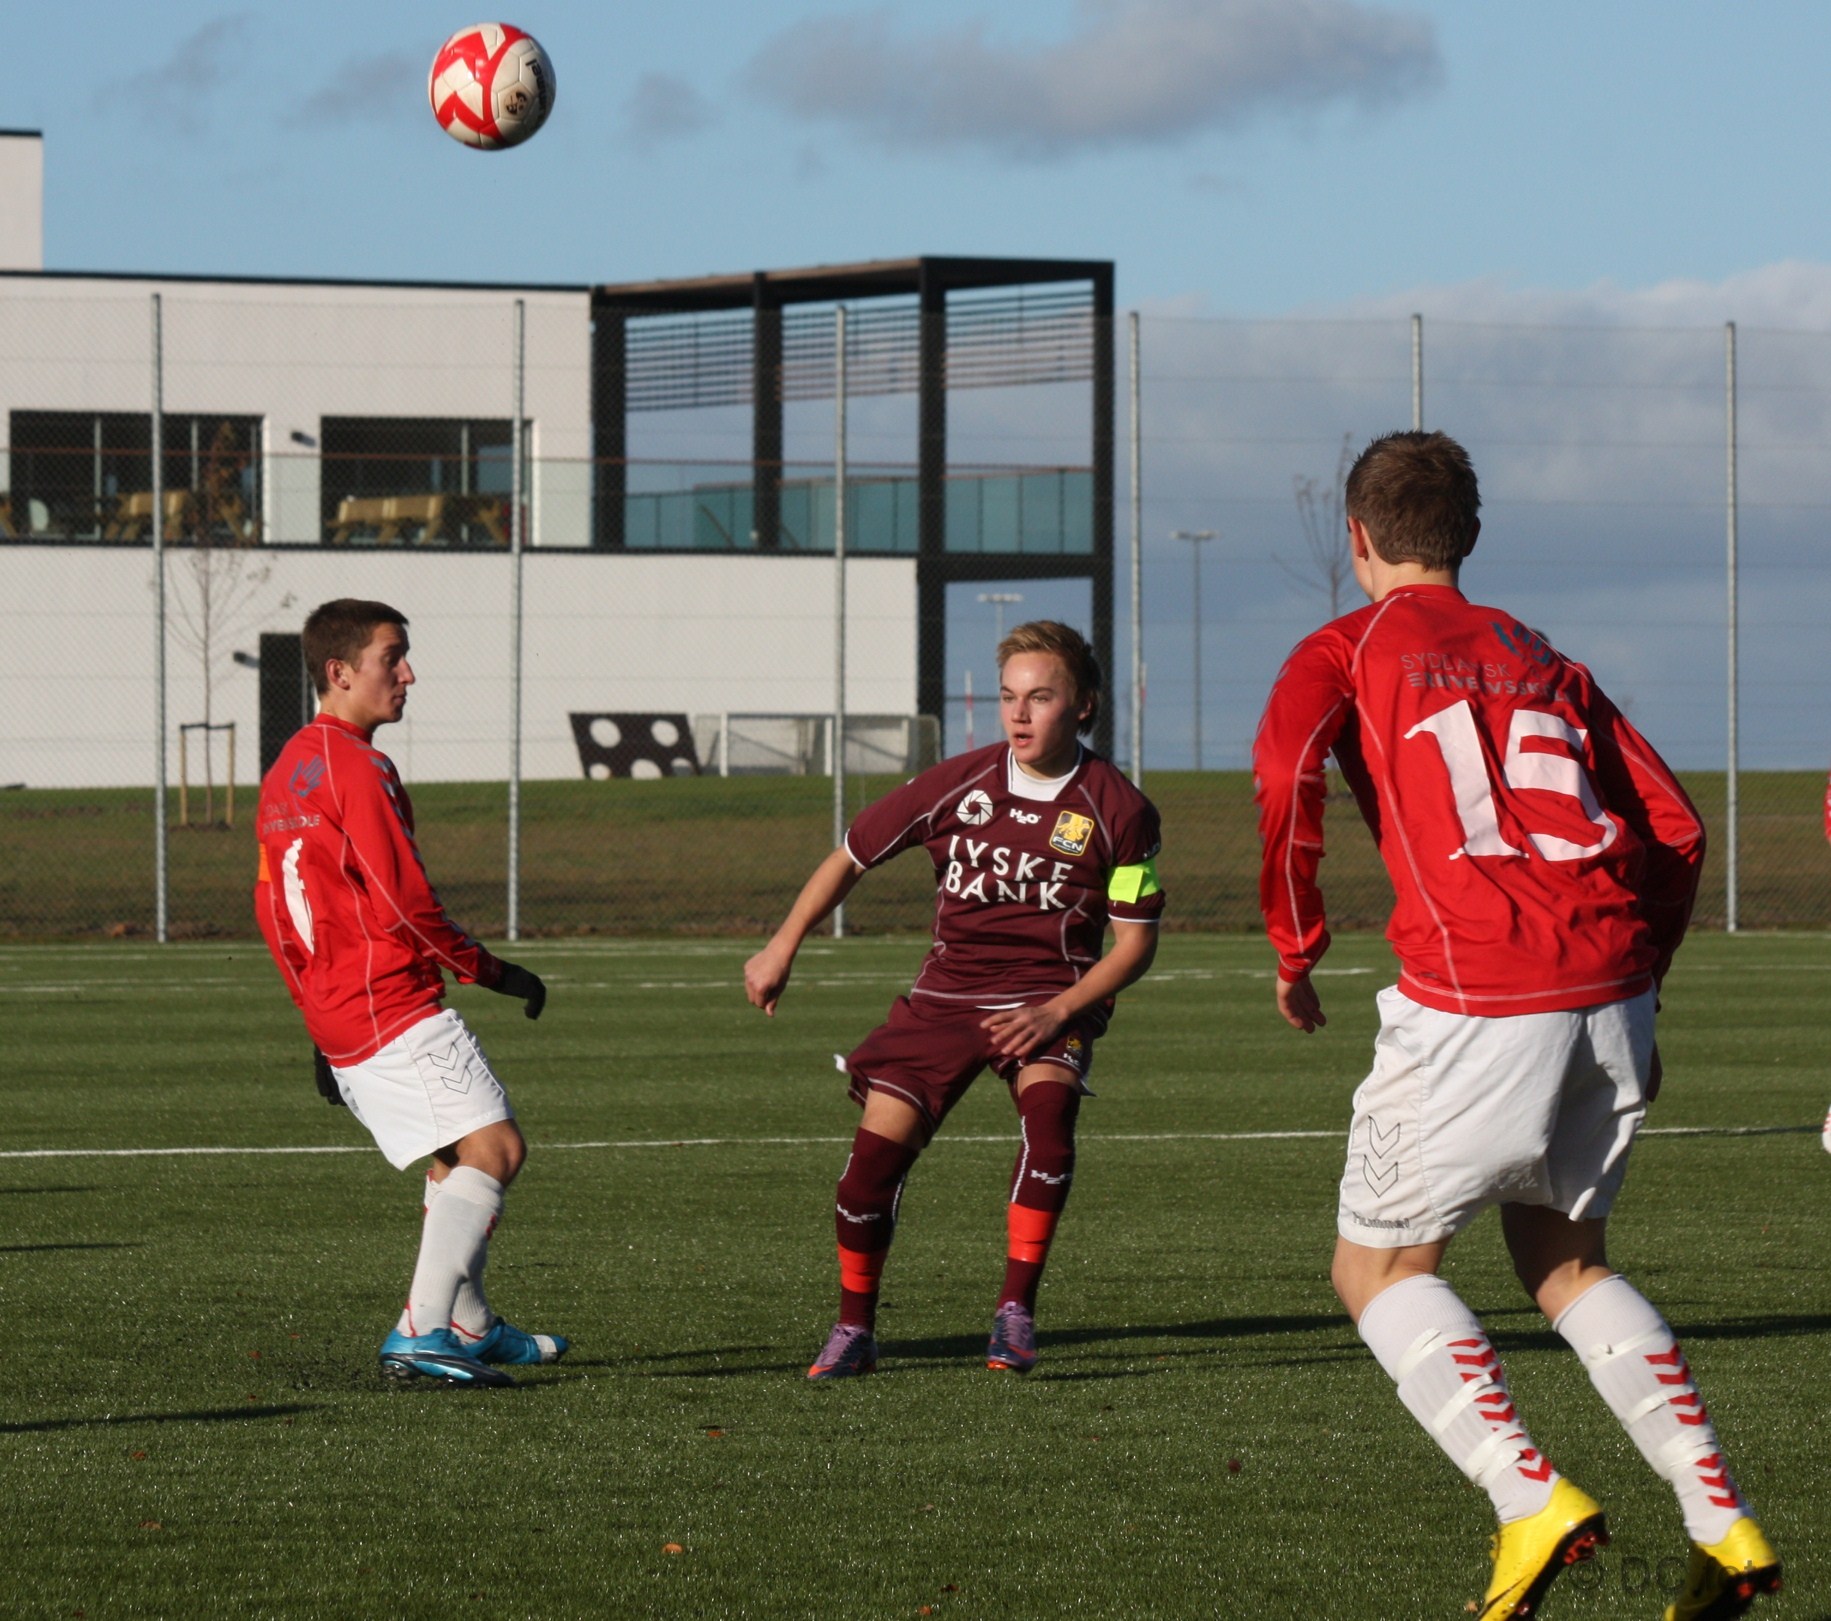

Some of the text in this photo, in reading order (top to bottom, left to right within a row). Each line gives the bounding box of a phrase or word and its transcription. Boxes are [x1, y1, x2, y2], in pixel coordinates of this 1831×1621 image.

[1403, 699, 1618, 862] 15
[1052, 836, 1083, 851] FCN
[945, 860, 1067, 911] BANK
